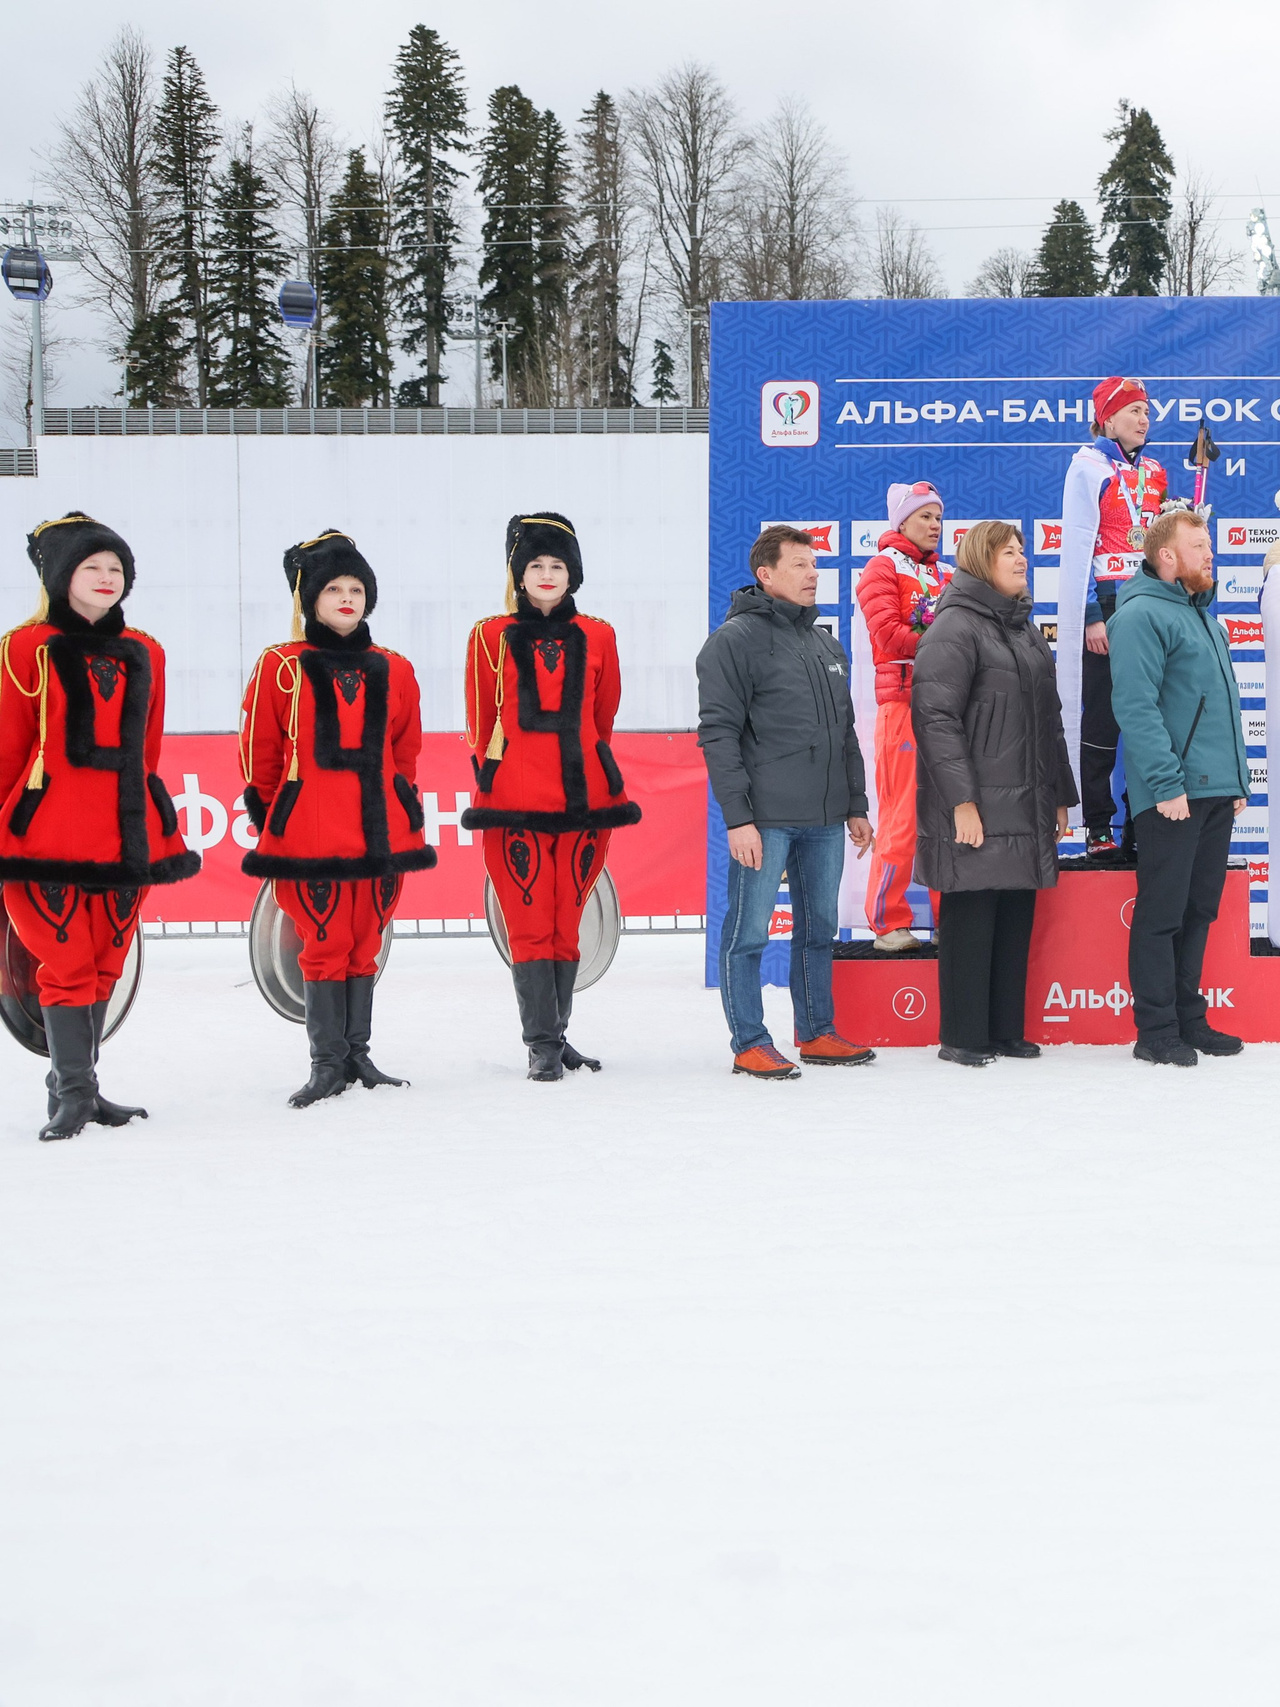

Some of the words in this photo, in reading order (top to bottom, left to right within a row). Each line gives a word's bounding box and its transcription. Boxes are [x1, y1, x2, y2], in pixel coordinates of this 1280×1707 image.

[836, 399, 1094, 424] АЛЬФА-БАН
[1153, 398, 1261, 422] УБОК
[1232, 627, 1260, 638] Альфа
[1237, 826, 1264, 834] ГАЗПРОМ
[775, 917, 793, 929] Аль
[904, 993, 915, 1014] 2
[1043, 981, 1135, 1022] Альф
